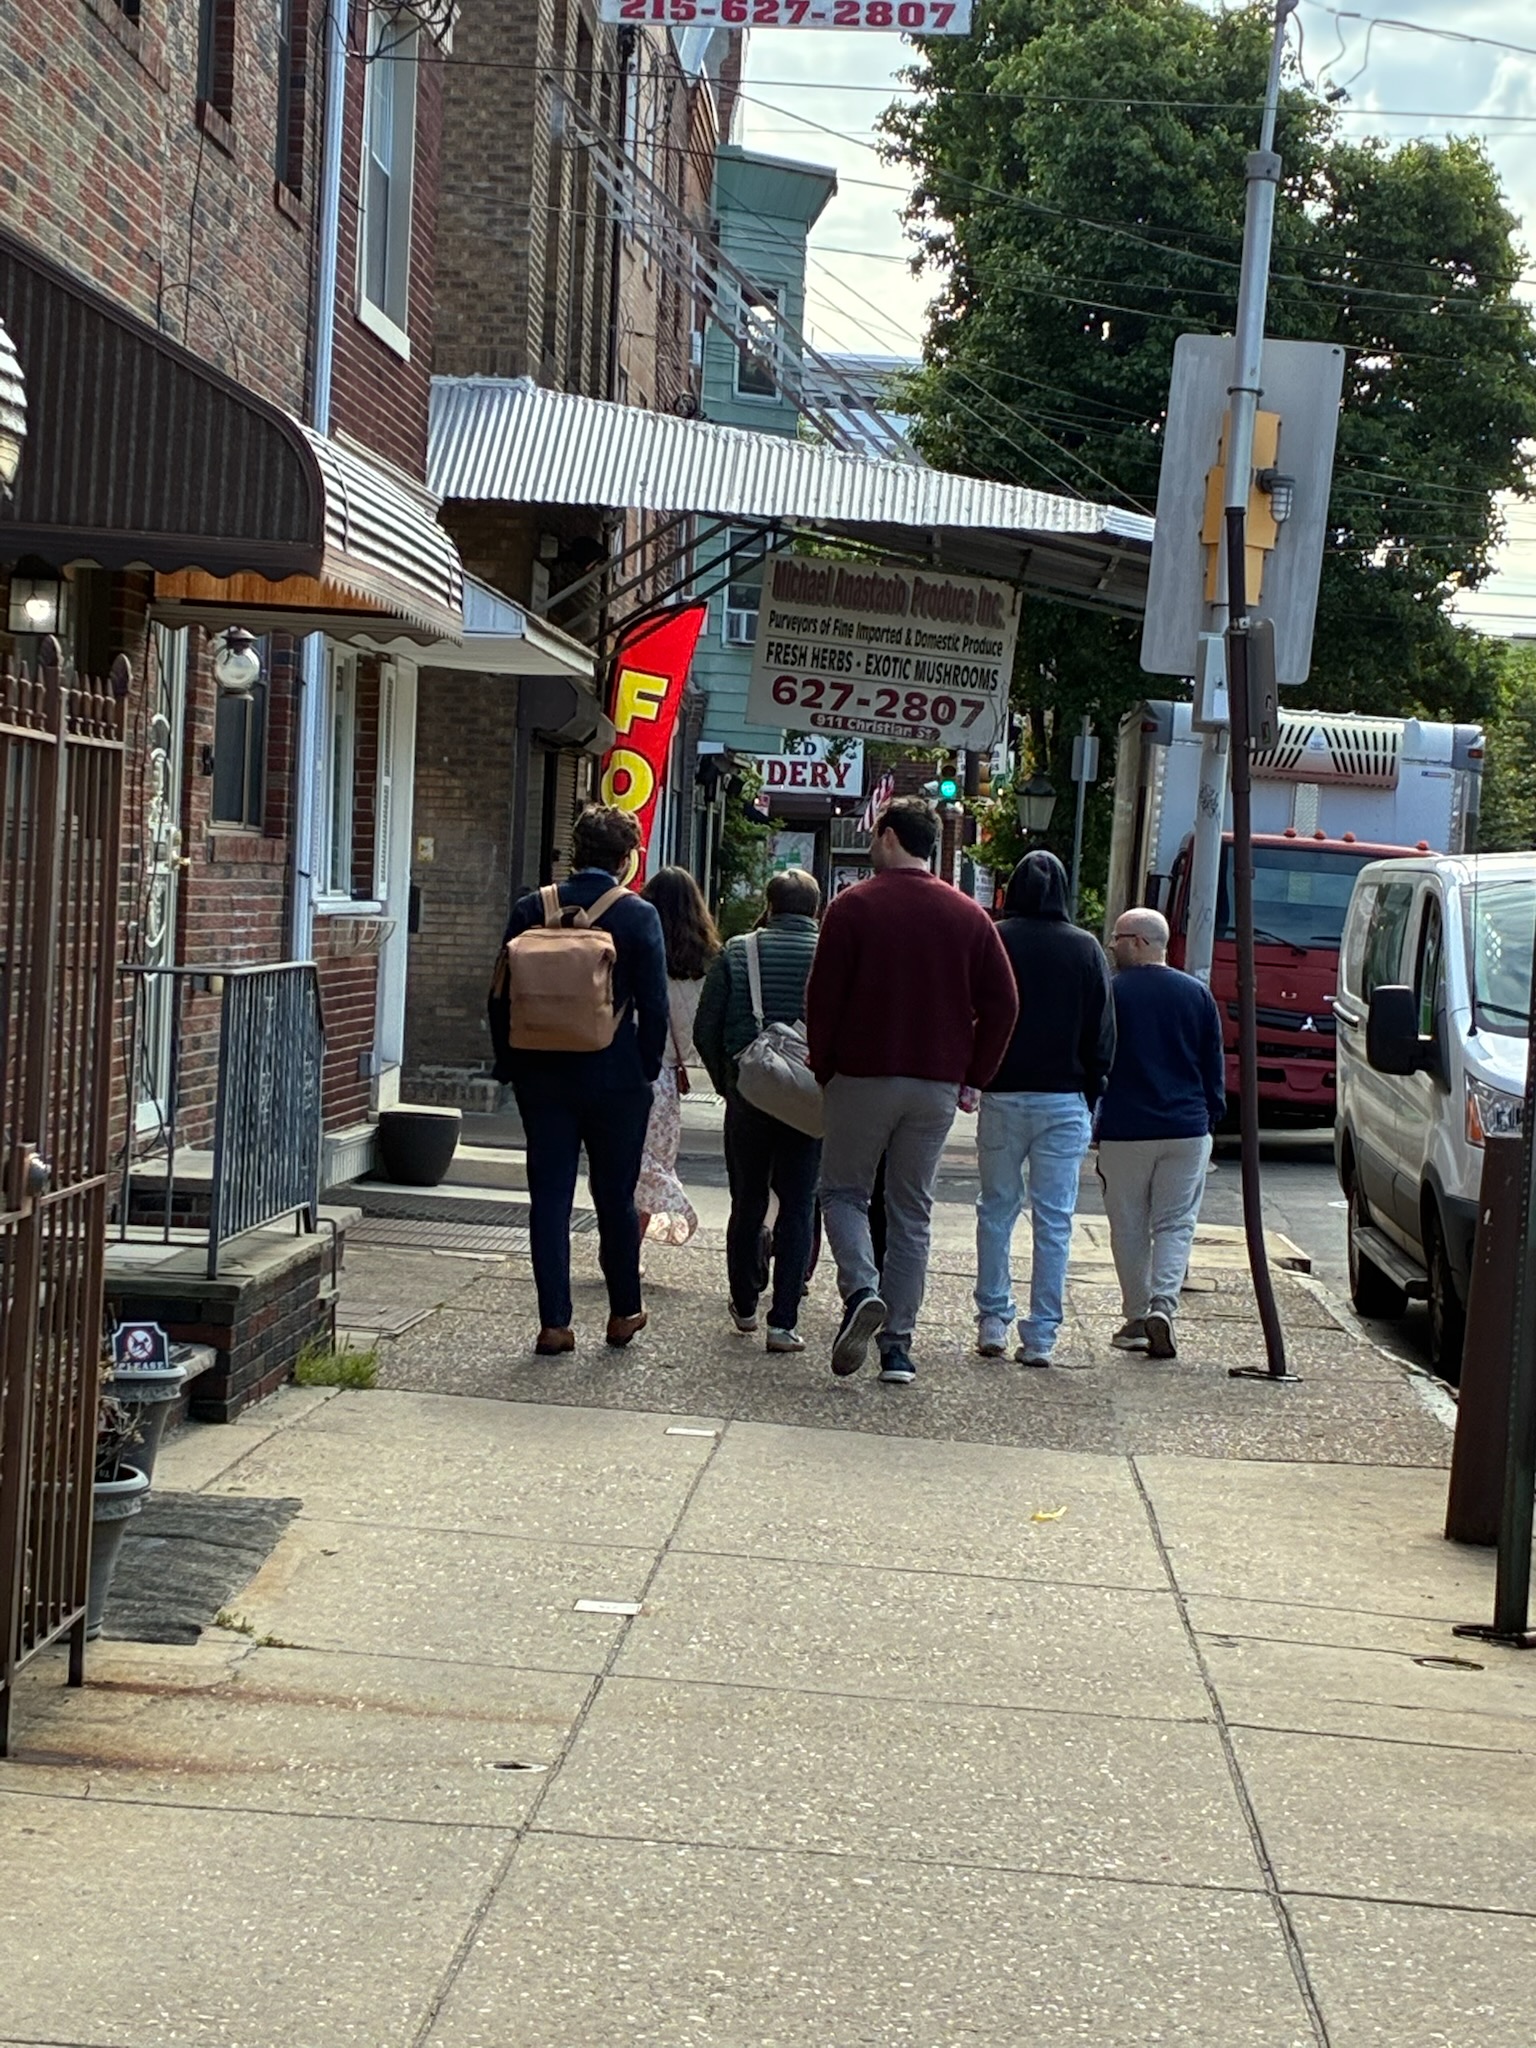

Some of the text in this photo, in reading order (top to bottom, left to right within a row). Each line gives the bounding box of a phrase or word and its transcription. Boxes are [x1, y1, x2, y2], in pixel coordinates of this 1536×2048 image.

[620, 0, 956, 28] 215-627-2807
[772, 560, 836, 607] Michael
[833, 568, 910, 617] Anastasio
[911, 576, 977, 626] Produce
[768, 609, 1003, 657] Purveyors of Fine Imported & Domestic Produce
[766, 641, 999, 691] FRESH HERBS EXOTIC MUSHROOMS
[772, 675, 985, 728] 627-2807
[816, 716, 843, 729] 911
[847, 716, 912, 737] Christian
[601, 669, 669, 887] FO
